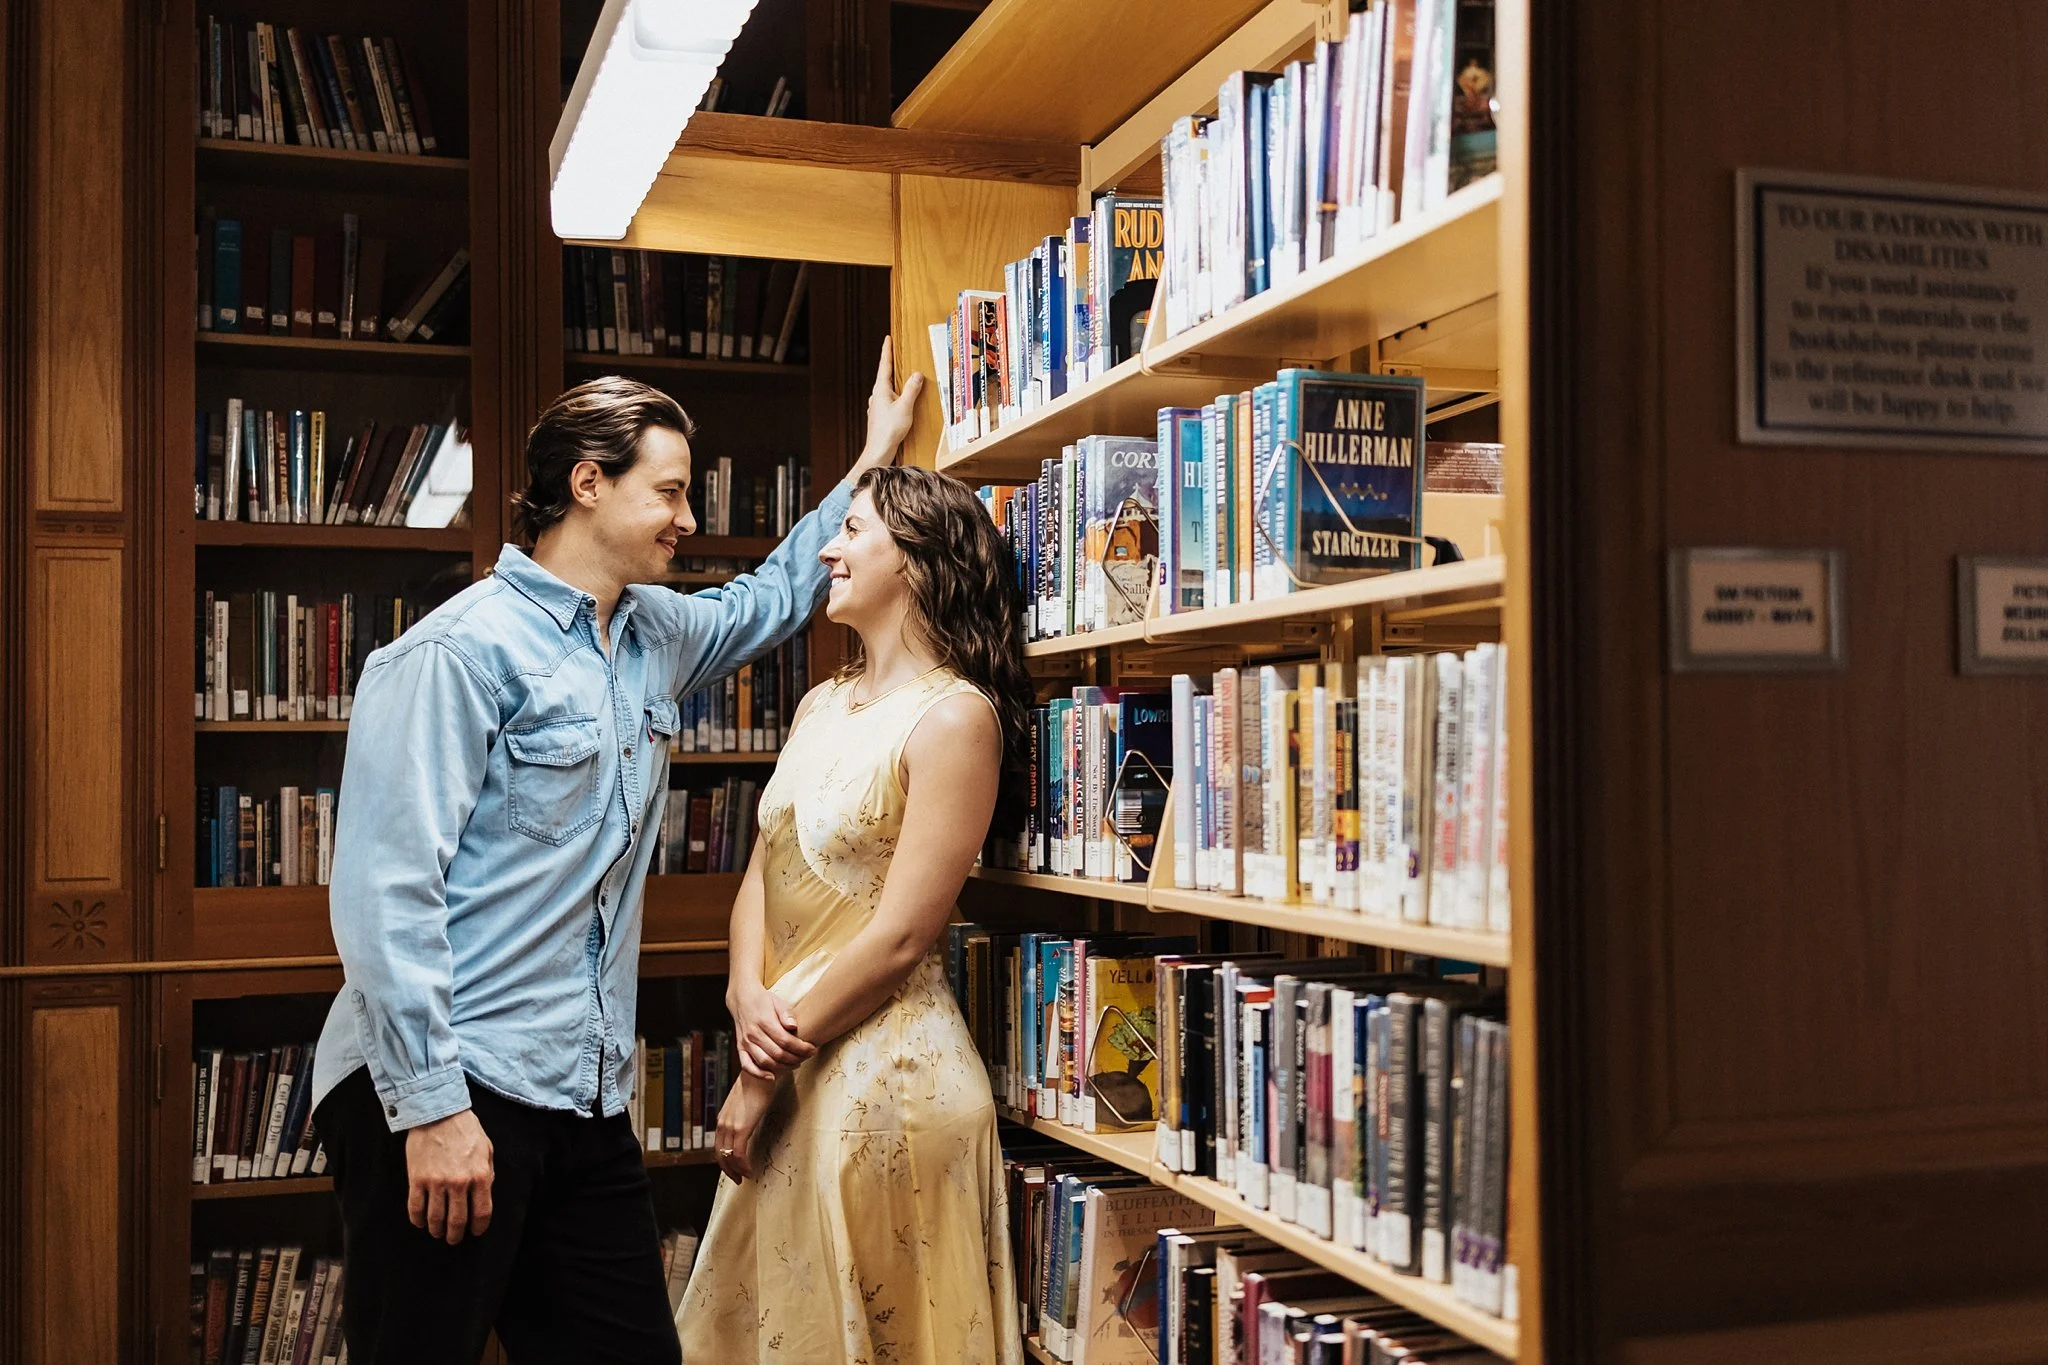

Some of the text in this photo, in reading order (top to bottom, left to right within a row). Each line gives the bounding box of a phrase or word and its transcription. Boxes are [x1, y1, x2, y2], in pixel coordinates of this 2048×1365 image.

[1115, 208, 1164, 249] RUD
[1778, 203, 2044, 245] TO OUR PATRONS WITH
[1834, 238, 1989, 270] DISABILITIES
[1828, 274, 1866, 297] you
[1042, 294, 1050, 333] WINTER
[1792, 300, 1813, 319] to
[2000, 309, 2029, 333] the
[1788, 328, 1911, 354] bookshelves
[1770, 360, 1792, 379] to
[1795, 358, 1826, 381] the
[1262, 404, 1271, 432] ANNE
[1278, 391, 1287, 421] ANNE
[1334, 399, 1386, 432] ANNE
[1851, 391, 1877, 414] be
[1881, 392, 1939, 422] happy
[1946, 397, 1968, 416] to
[1216, 413, 1226, 439] ANNE
[1304, 432, 1412, 469] HILLERMAN
[1216, 443, 1226, 505] HILLERMAN
[1312, 530, 1399, 559] STARGAZER
[1075, 698, 1083, 751] DREAMER
[1223, 706, 1233, 763] HILLERMAN
[1029, 764, 1037, 808] GROUND
[1075, 776, 1083, 804] JACK
[1091, 783, 1098, 793] By
[199, 1067, 207, 1078] THE
[198, 1096, 206, 1123] OUTBACK
[1106, 1208, 1206, 1227] FELLINI
[258, 1259, 273, 1280] TONY
[281, 1255, 295, 1271] TONY
[232, 1269, 249, 1326] ANNE HILLERMAN
[250, 1280, 269, 1325] HILLERMAN
[274, 1272, 292, 1309] HILLERMAN
[267, 1318, 284, 1341] SACRED
